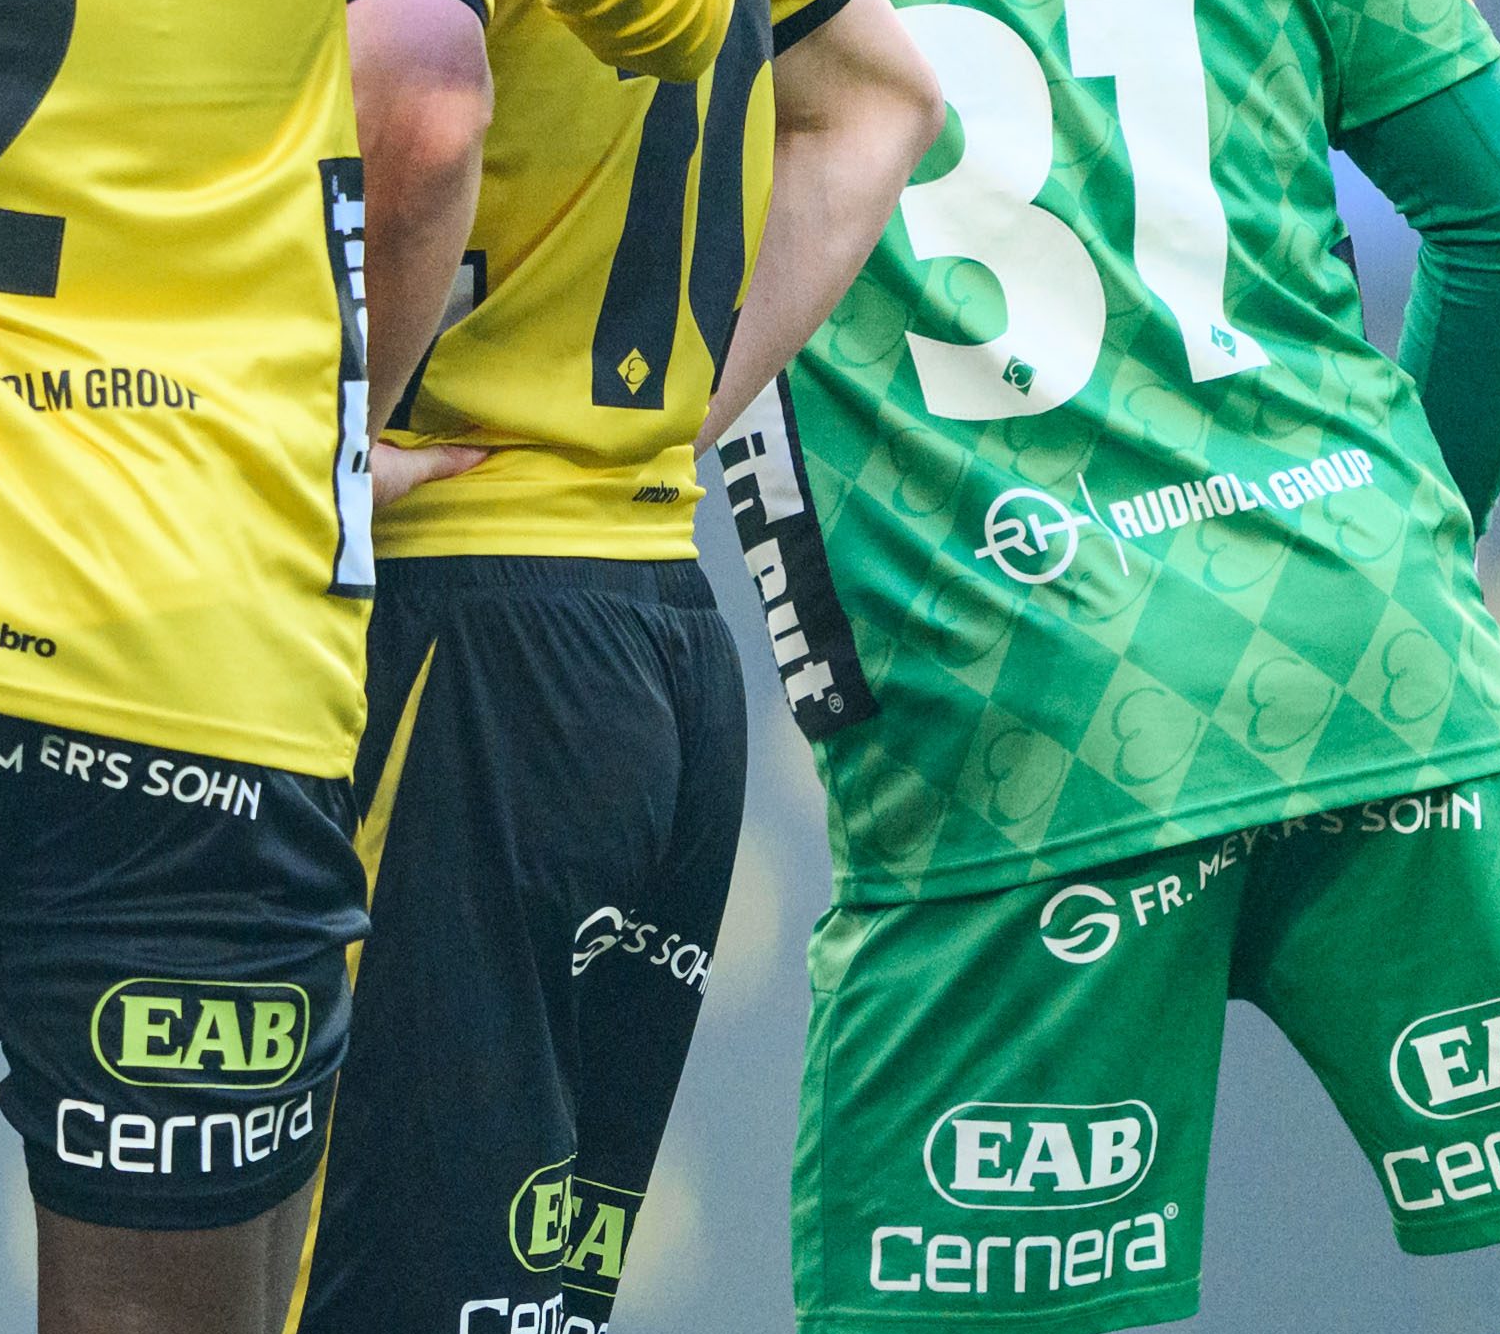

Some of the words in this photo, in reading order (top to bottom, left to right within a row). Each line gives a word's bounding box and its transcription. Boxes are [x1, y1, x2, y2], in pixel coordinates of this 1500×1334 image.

[1267, 449, 1374, 511] GROUP
[142, 759, 262, 821] SOHN
[1130, 873, 1194, 927] FR.
[1361, 791, 1483, 835] SOHN
[116, 994, 297, 1071] EAB
[56, 1090, 314, 1174] Cernera
[949, 1116, 1143, 1193] EAB
